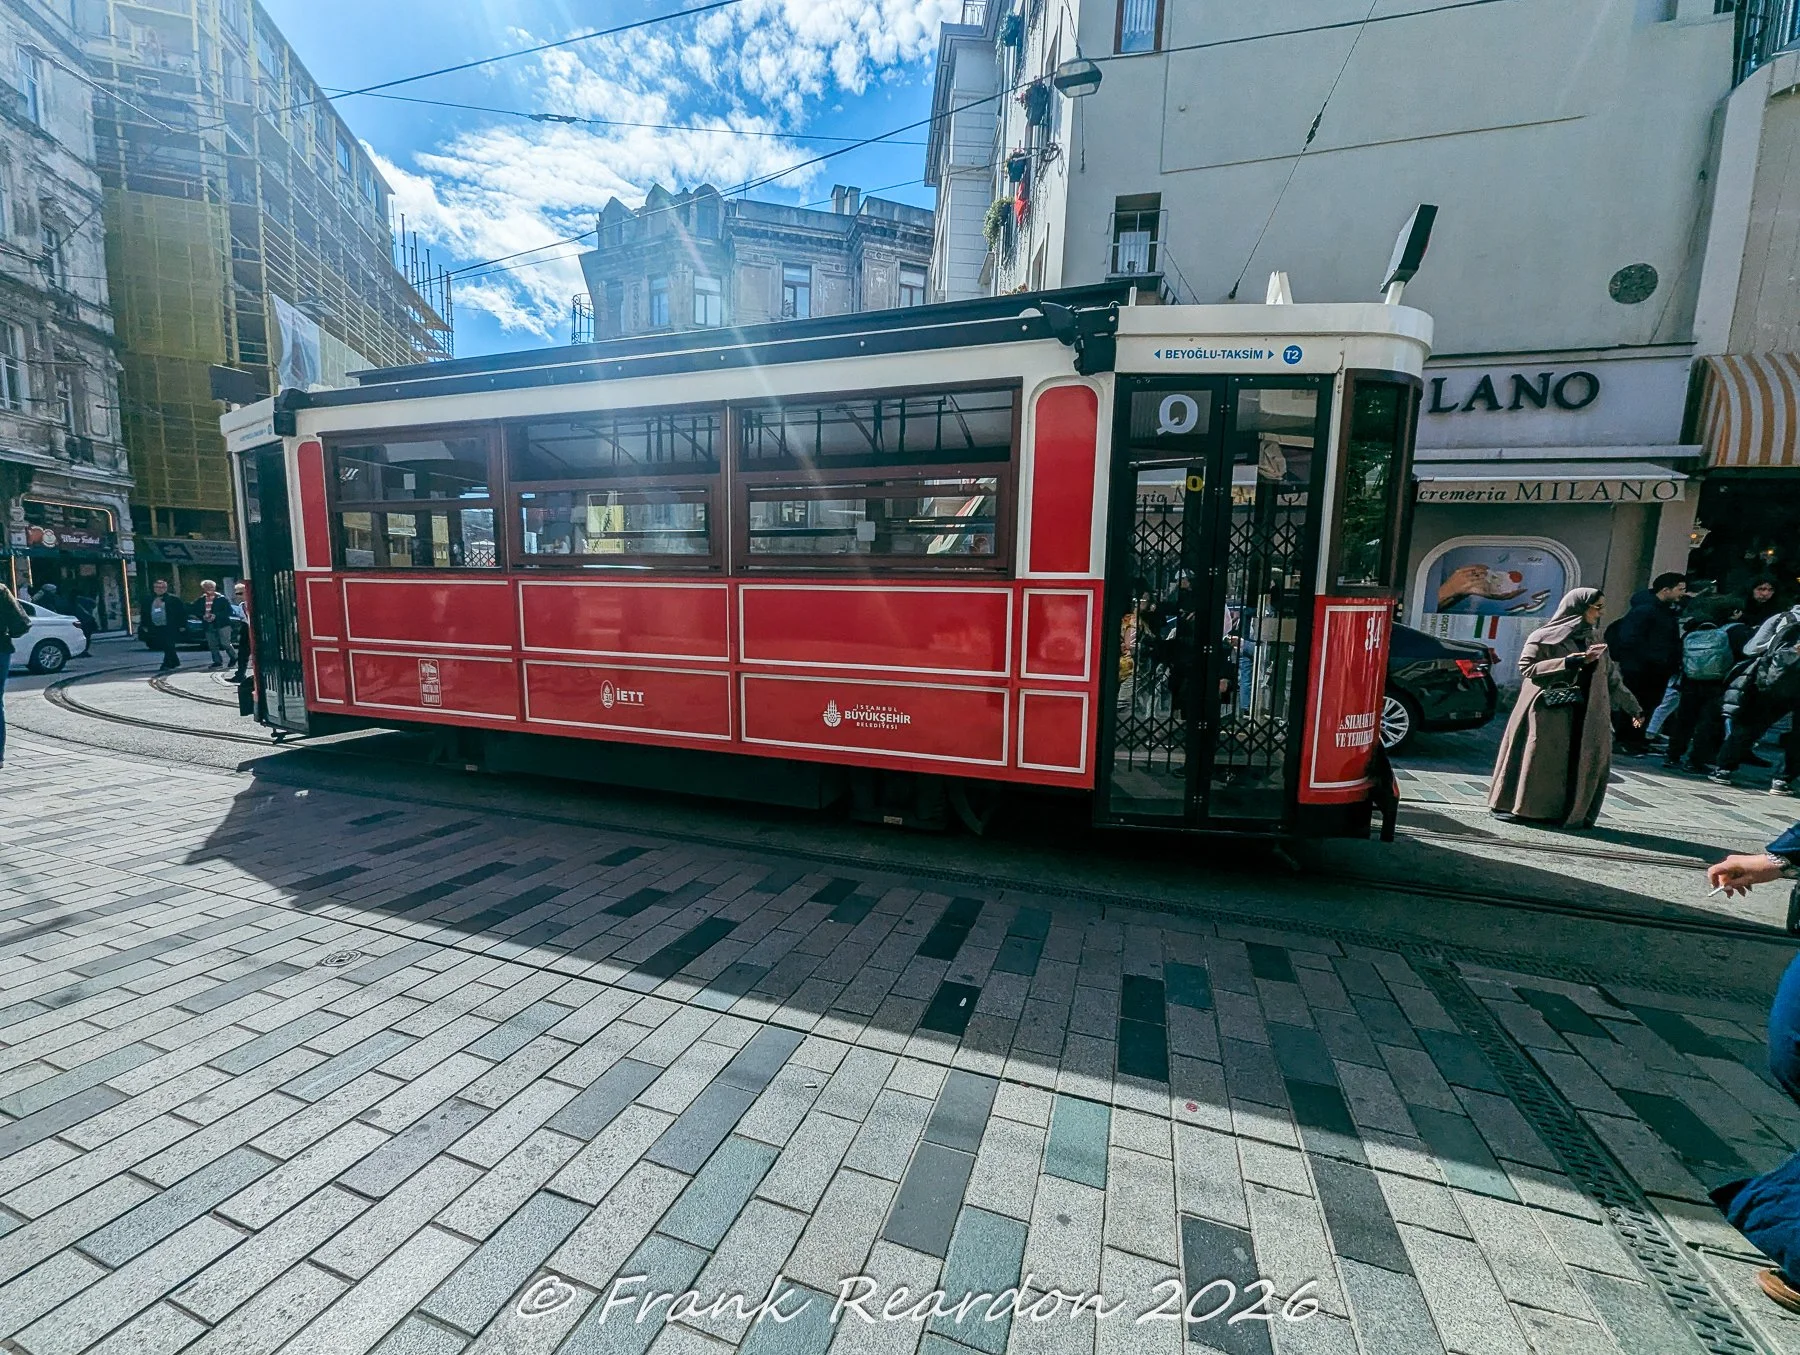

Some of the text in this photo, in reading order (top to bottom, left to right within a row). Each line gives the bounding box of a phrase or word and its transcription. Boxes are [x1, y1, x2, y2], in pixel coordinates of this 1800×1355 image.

[1165, 347, 1299, 360] BEYOĞLU-TAKSİM T2
[1428, 371, 1600, 413] LANO
[1418, 481, 1679, 501] cremeria MILANO
[844, 708, 911, 724] BÜYÜKŞEHİR
